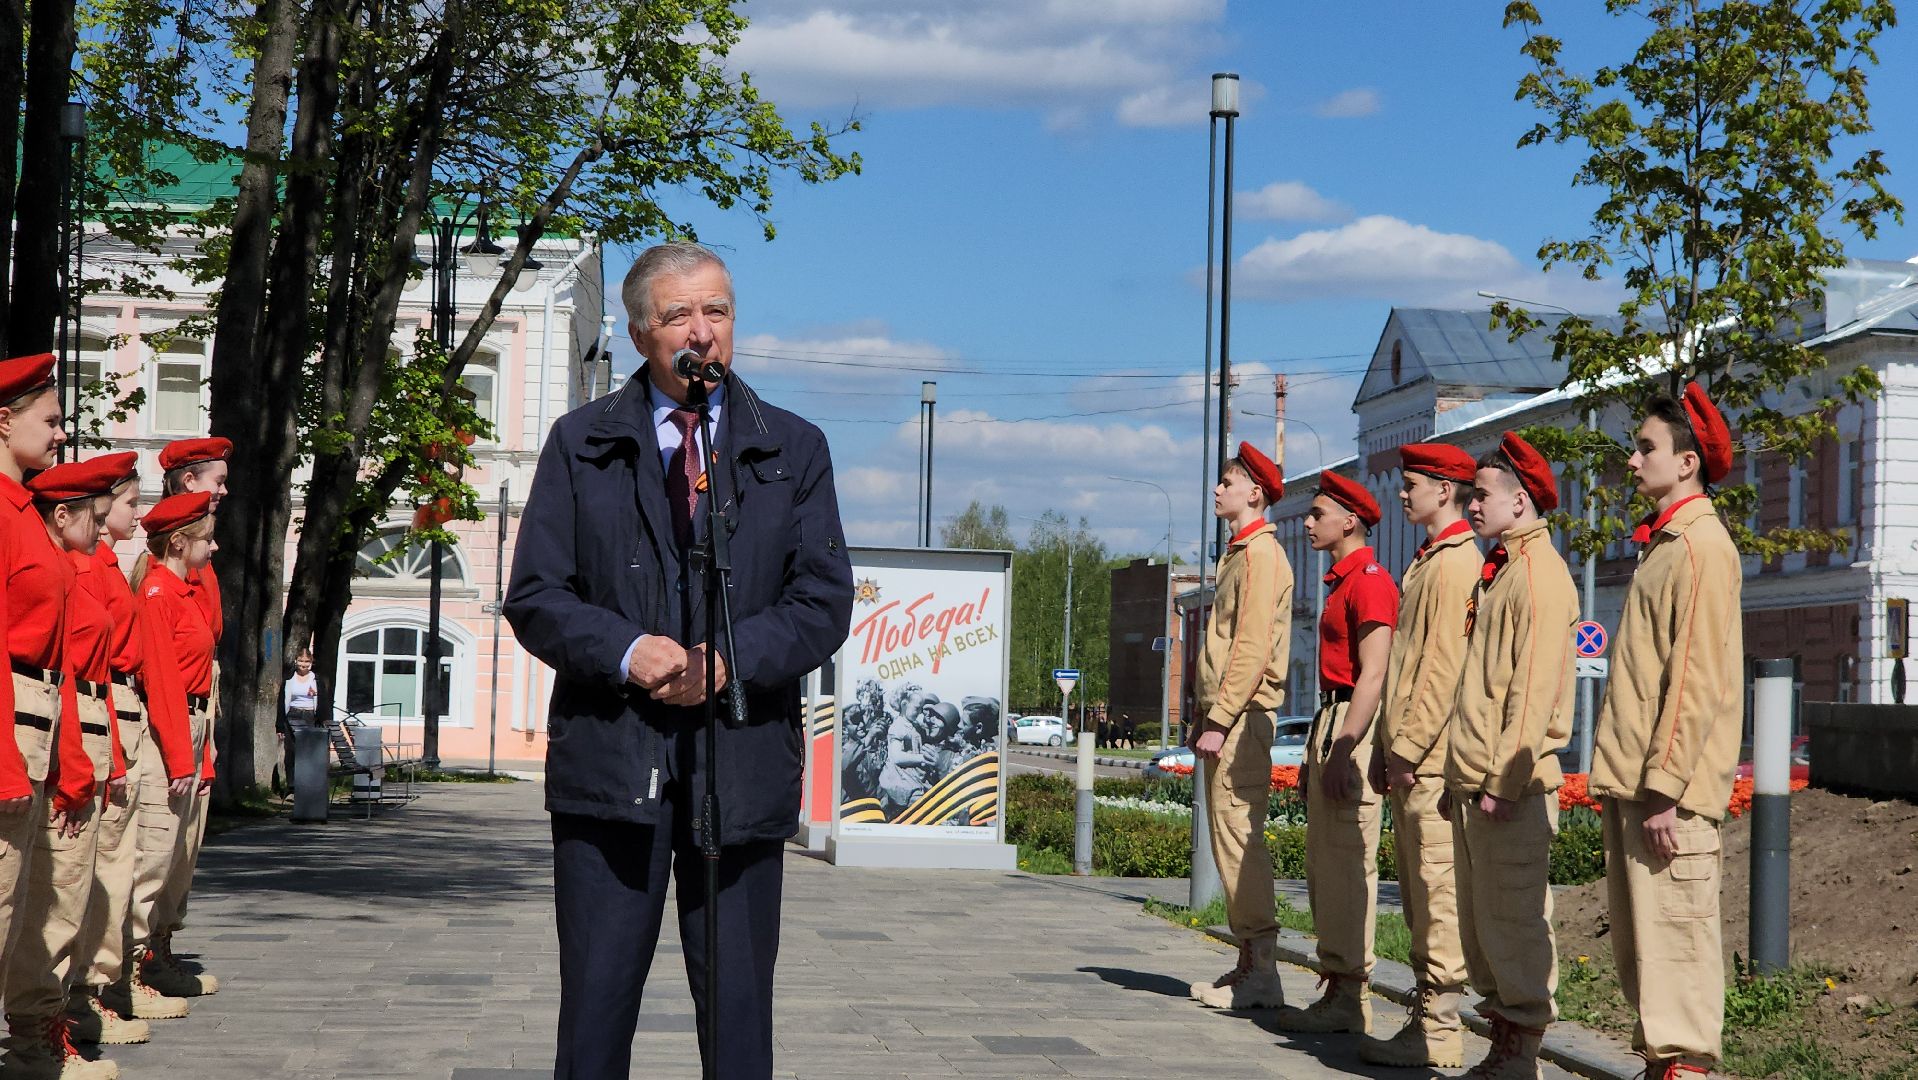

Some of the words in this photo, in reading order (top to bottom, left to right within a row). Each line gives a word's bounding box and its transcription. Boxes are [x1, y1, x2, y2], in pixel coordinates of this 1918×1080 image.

[853, 587, 990, 674] Победа!
[878, 652, 924, 680] ОДНА
[927, 642, 952, 661] НА
[954, 624, 998, 652] ВСЕХ
